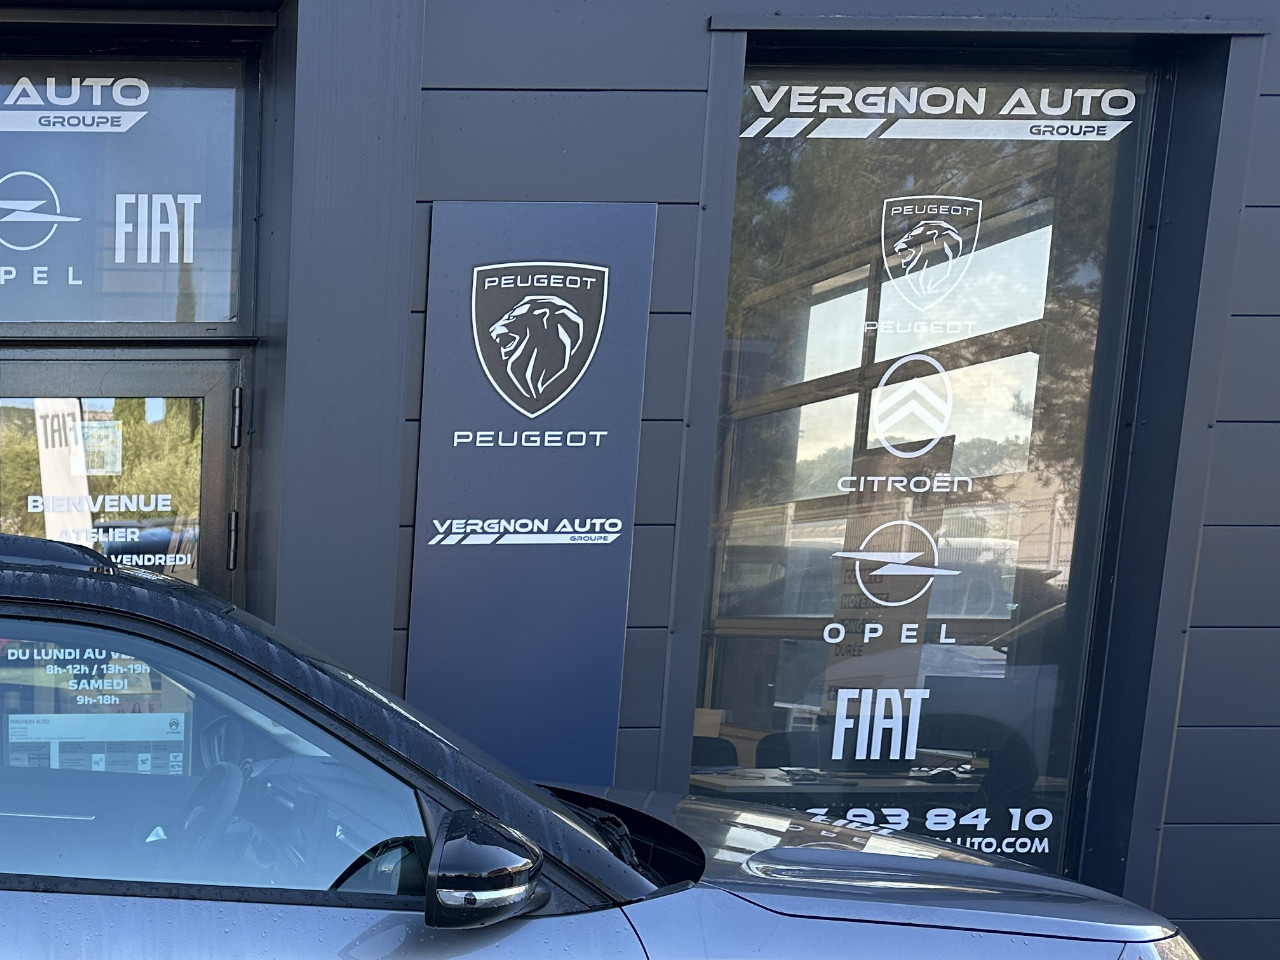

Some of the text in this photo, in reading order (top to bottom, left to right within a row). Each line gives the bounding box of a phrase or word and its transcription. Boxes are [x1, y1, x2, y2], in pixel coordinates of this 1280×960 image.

[3, 76, 150, 106] AUTO
[750, 85, 1136, 116] VERGNON AUTO
[38, 115, 122, 128] GROUPE
[1029, 125, 1108, 136] GROUPE
[891, 204, 974, 216] PEUGEOT
[114, 194, 202, 263] FIAT
[484, 275, 596, 290] PEUGEOT
[864, 320, 979, 334] PEUGEOT
[453, 431, 608, 447] PEUGEOT
[837, 473, 973, 493] CITROËN
[27, 494, 172, 513] BIENVENUE
[432, 518, 623, 533] VERGNON AUTO
[59, 528, 140, 542] ATELIER
[111, 553, 191, 566] VENDREDI
[823, 623, 956, 643] OPEL
[7, 649, 30, 660] DU
[33, 648, 80, 660] LUNDI
[84, 648, 106, 659] AU
[834, 643, 863, 657] DURÉE
[45, 664, 150, 675] 8h-12h / 13h-19h
[68, 679, 128, 690] SAMEDI
[76, 695, 119, 705] 9h-18h
[831, 688, 930, 760] FIAT
[925, 808, 991, 831] 84
[1008, 808, 1053, 831] 10
